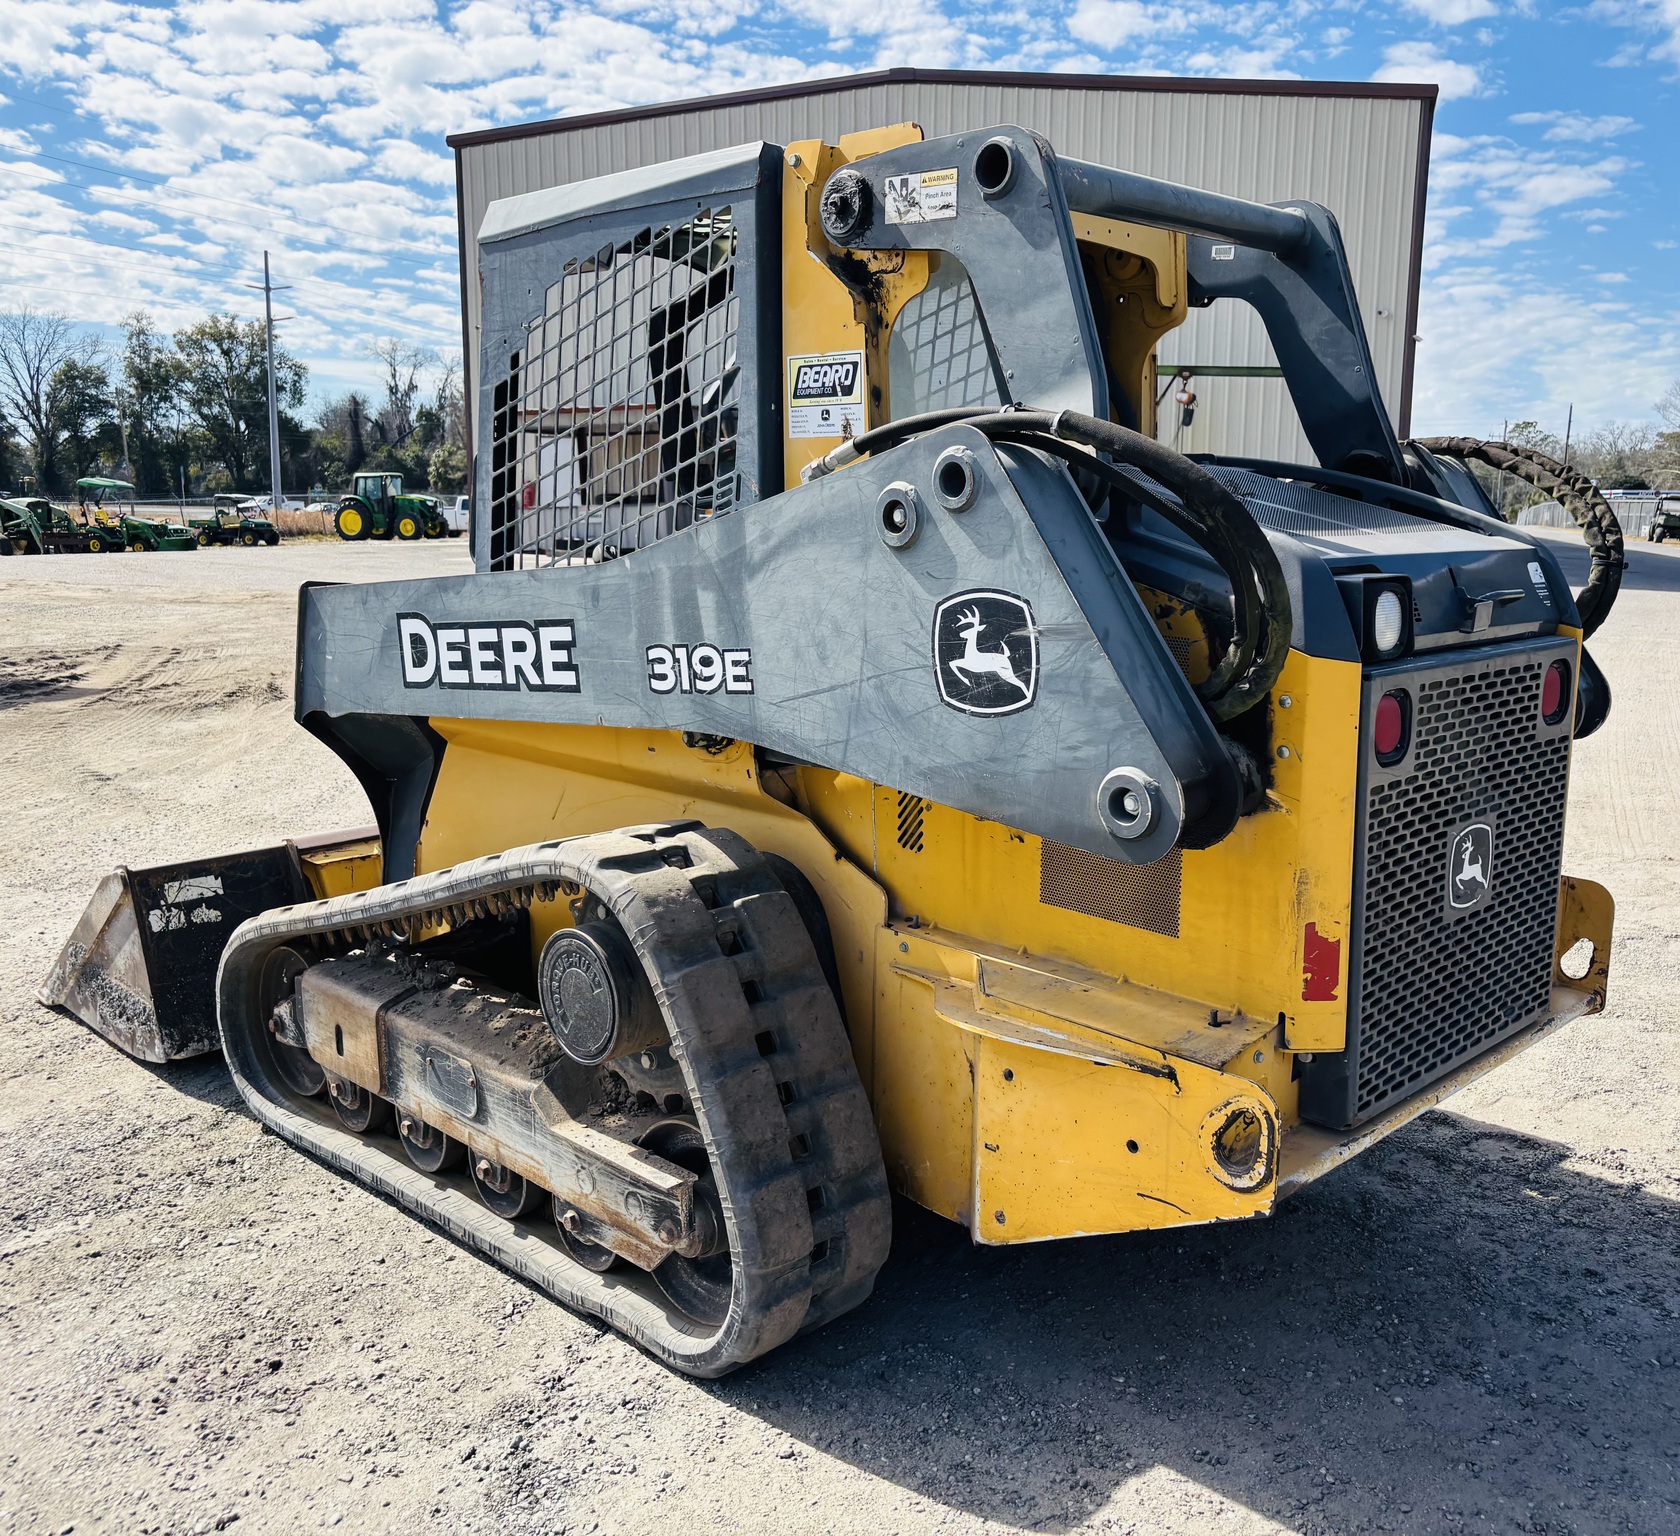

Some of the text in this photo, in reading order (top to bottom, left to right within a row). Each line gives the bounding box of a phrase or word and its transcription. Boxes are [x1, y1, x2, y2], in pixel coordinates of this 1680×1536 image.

[928, 174, 954, 182] WARNING
[798, 364, 854, 396] BEARD
[398, 616, 579, 688] DEERE
[647, 645, 753, 693] 319E
